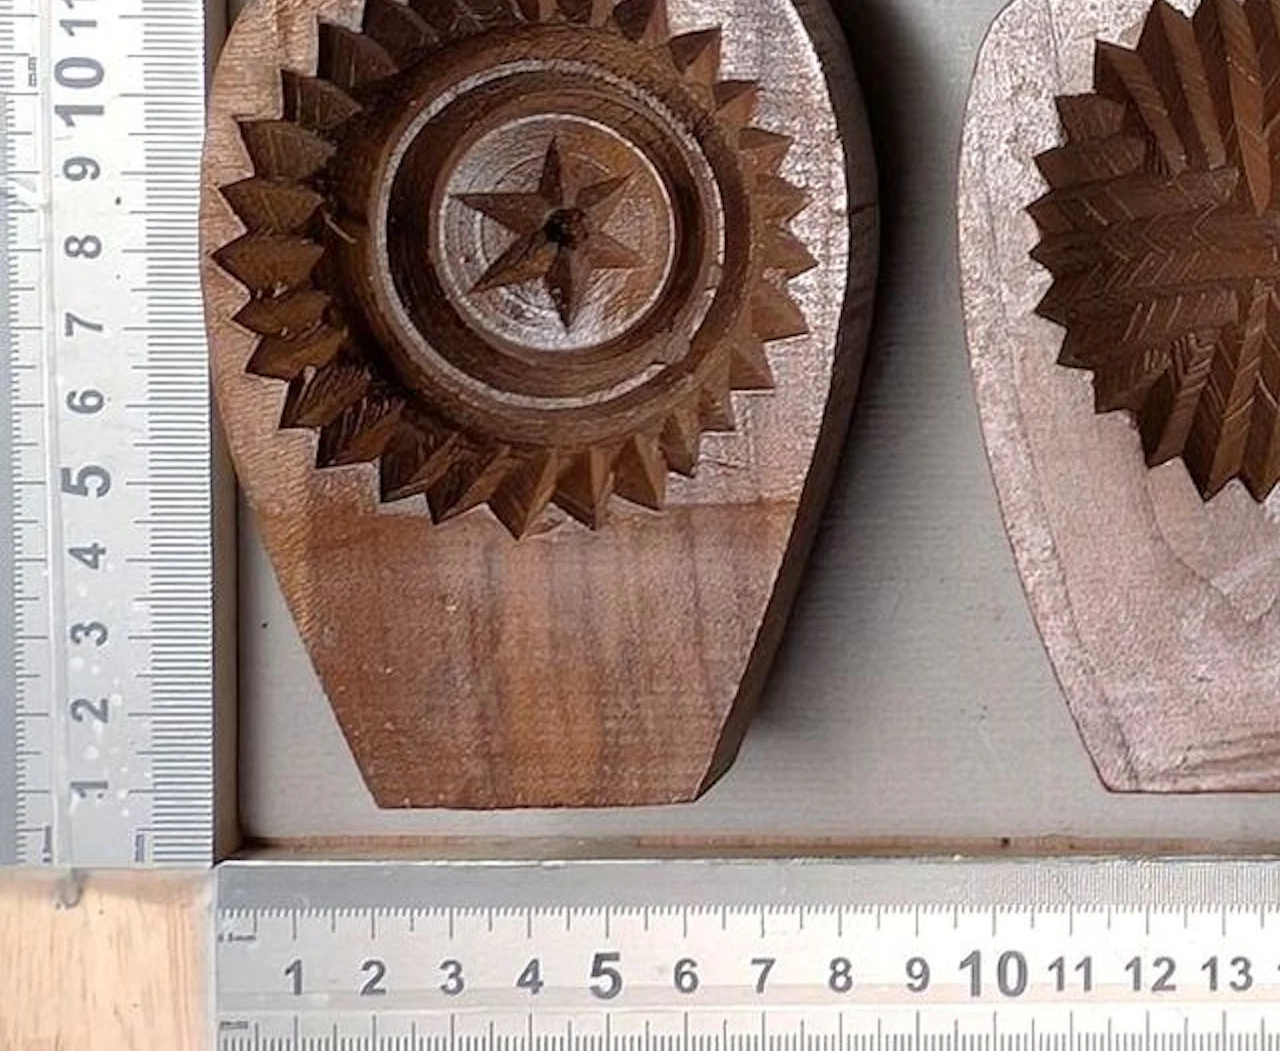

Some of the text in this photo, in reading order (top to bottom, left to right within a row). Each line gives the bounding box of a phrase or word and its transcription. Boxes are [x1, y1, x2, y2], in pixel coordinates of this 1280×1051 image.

[53, 56, 106, 128] 10
[61, 155, 102, 182] 9
[63, 234, 103, 260] 8
[64, 311, 105, 338] 7
[65, 389, 105, 415] 6
[59, 465, 112, 498] 5
[67, 542, 107, 571] 4
[69, 621, 109, 647] 3
[69, 697, 109, 724] 2
[69, 780, 110, 799] 1
[283, 958, 304, 997] 1
[359, 959, 388, 998] 2
[439, 958, 465, 998] 3
[515, 957, 545, 996] 4
[588, 951, 623, 1001] 5
[673, 957, 700, 995] 6
[749, 956, 777, 996] 7
[827, 955, 854, 995] 8
[904, 955, 931, 994] 9
[957, 948, 1029, 999] 10
[1047, 954, 1093, 994] 11
[1123, 955, 1178, 994] 12
[1200, 954, 1254, 993] 13
